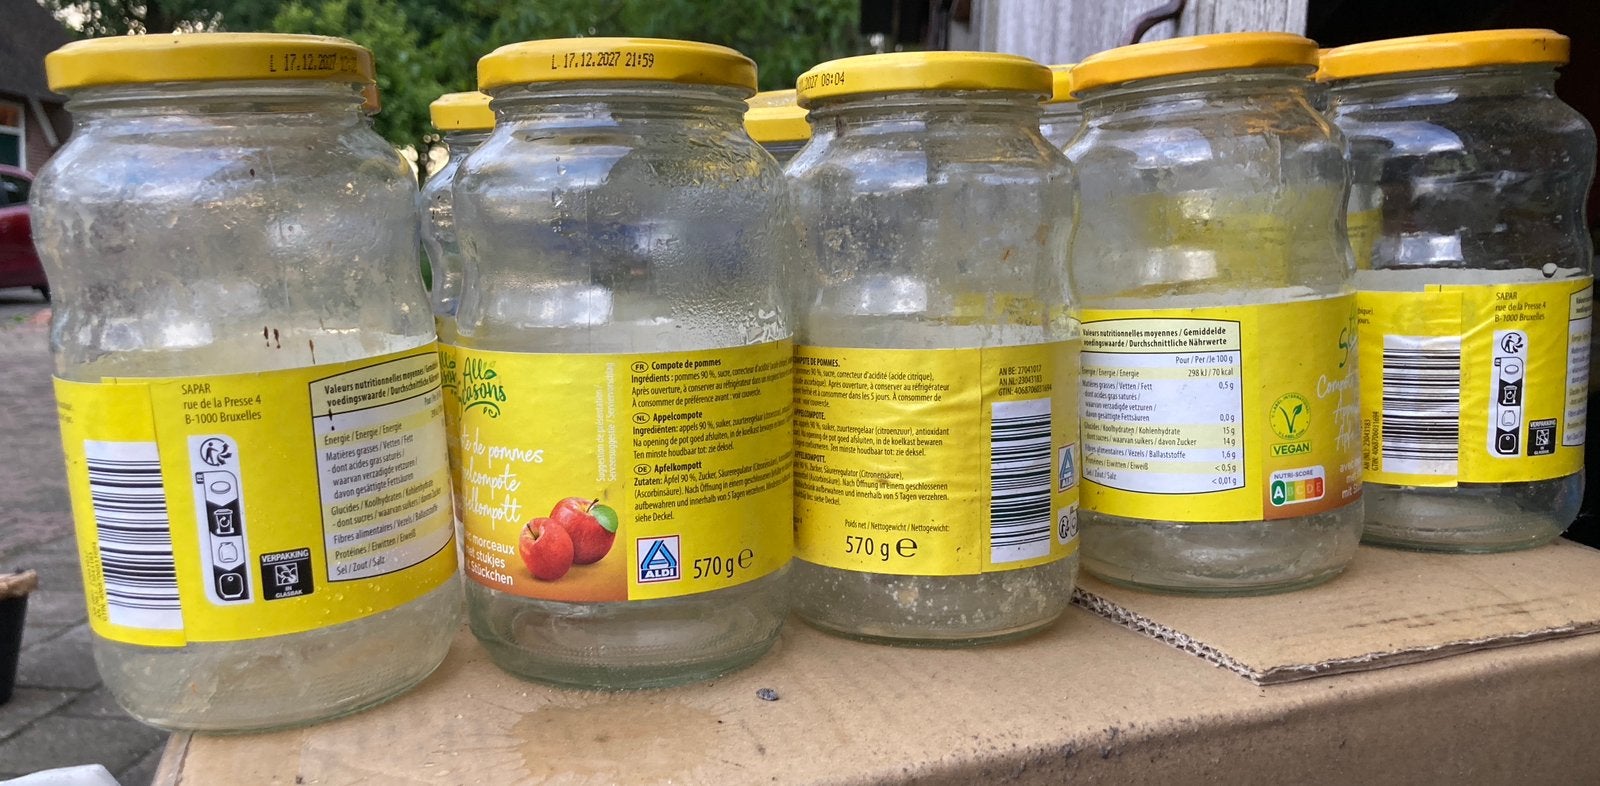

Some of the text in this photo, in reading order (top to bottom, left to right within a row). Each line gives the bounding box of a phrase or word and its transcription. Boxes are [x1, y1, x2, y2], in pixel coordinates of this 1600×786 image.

[564, 52, 620, 68] 17.12.2027
[625, 52, 654, 68] 21:59
[822, 72, 844, 86] 08:04
[1496, 292, 1517, 300] SAPAR
[1520, 312, 1544, 321] Bruxelles
[1184, 327, 1226, 336] Gemiddelde
[1129, 339, 1187, 347] Durchschnittliche
[652, 361, 683, 371] Compote
[685, 360, 693, 368] de
[694, 359, 721, 369] pommes
[632, 374, 670, 385] Ingrédients
[675, 373, 699, 382] pommes
[907, 372, 934, 382] citrique),
[1120, 369, 1139, 378] Energie
[182, 384, 211, 395] SAPAR
[324, 383, 353, 394] Valeurs
[355, 374, 402, 390] nutritionnelles
[632, 383, 714, 397] Après ouverture, conserver
[912, 382, 950, 393] réfrigérateur
[184, 395, 261, 409] rue de la Presse 4
[327, 389, 386, 407] voedingswaarde
[638, 395, 714, 407] consommer préférence
[185, 410, 261, 424] B-1000 Bruxelles
[653, 411, 702, 423] Appelcompote
[1121, 413, 1149, 421] Fettsäuren
[633, 422, 698, 437] Ingrediënten: appels
[916, 427, 949, 436] antioxidant
[1139, 428, 1180, 436] Kohlenhydrate
[324, 427, 378, 446] Énergie Energie
[643, 437, 668, 448] opening
[679, 436, 688, 446] pot
[690, 434, 704, 444] goed
[891, 437, 915, 446] koelkast
[326, 444, 378, 461] Matières grasses
[474, 427, 485, 455] de
[488, 446, 544, 469] pommes
[634, 447, 696, 459] Ten minste houdbaar
[856, 446, 883, 456] houdbaar
[905, 448, 926, 456] deksel.
[1273, 443, 1310, 455] VEGAN
[332, 463, 348, 473] dont
[654, 461, 702, 474] Apfelkompott
[1130, 462, 1148, 470] Eiweiß
[333, 474, 362, 486] waarvan
[463, 456, 520, 500] elcompote
[1274, 470, 1313, 479] NUTRI-SCORE
[634, 477, 662, 486] Zutaten:
[905, 482, 948, 492] geschlossenen
[334, 488, 355, 499] davon
[634, 485, 699, 499] (Ascorbinsäure). Nach
[900, 492, 917, 502] Tagen
[1274, 486, 1284, 499] A
[331, 504, 360, 516] Glucides
[635, 498, 688, 510] aufbewahren und
[336, 511, 373, 528] dont sucres
[635, 511, 674, 522] siehe Deckel.
[334, 522, 392, 544] Fibres alimentaires
[870, 523, 950, 533] Nettogewicht Nettogewicht:
[473, 535, 514, 555] morceaux
[845, 536, 874, 555] 570
[881, 542, 889, 561] g
[262, 550, 309, 562] VERPAKKING
[335, 547, 367, 560] Protéines
[476, 550, 506, 568] stukjes
[337, 565, 348, 576] Sel
[353, 560, 368, 572] Zout
[471, 560, 513, 585] Stückchen
[694, 556, 722, 579] 570
[726, 557, 734, 578] g
[645, 569, 674, 579] ALDI
